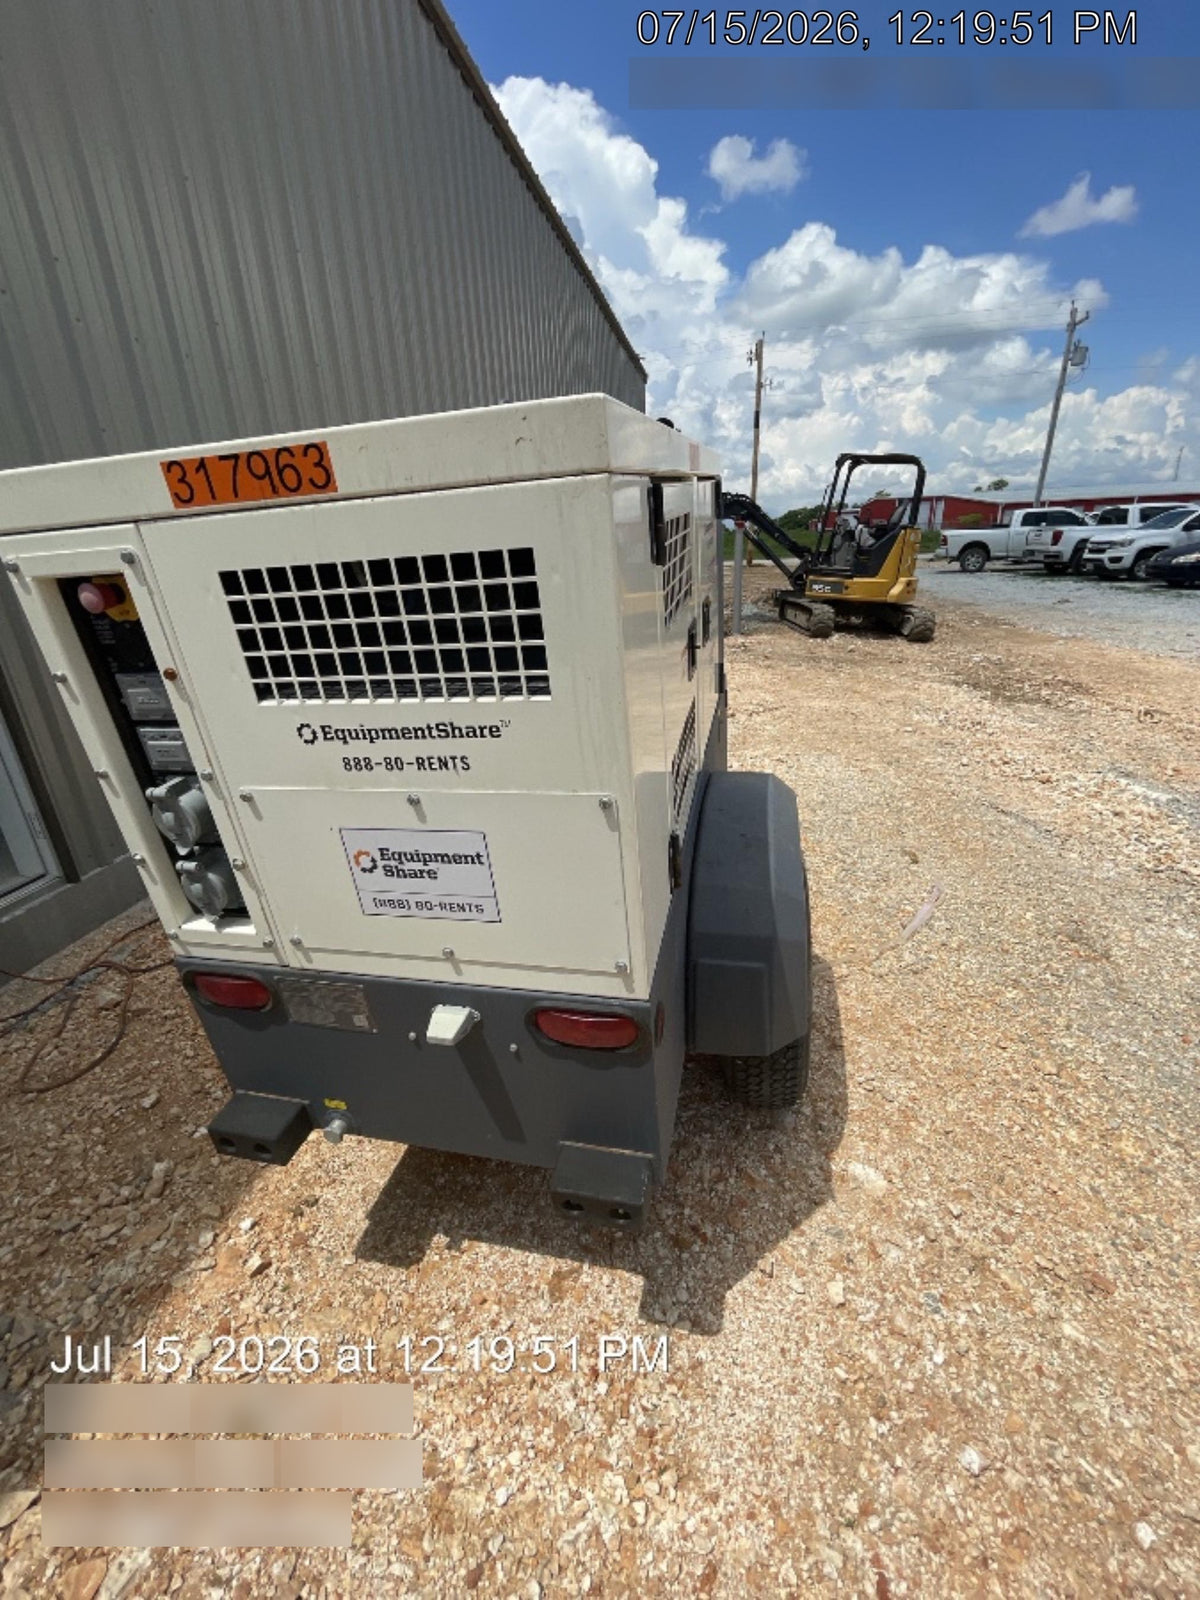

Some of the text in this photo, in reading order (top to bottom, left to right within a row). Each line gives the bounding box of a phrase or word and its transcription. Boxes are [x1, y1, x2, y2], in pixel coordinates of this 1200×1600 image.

[166, 443, 332, 504] 317963
[320, 721, 502, 744] EquipmentShare
[342, 755, 471, 772] 888-80-RENTS
[378, 847, 485, 866] Equipment
[381, 863, 438, 880] Share
